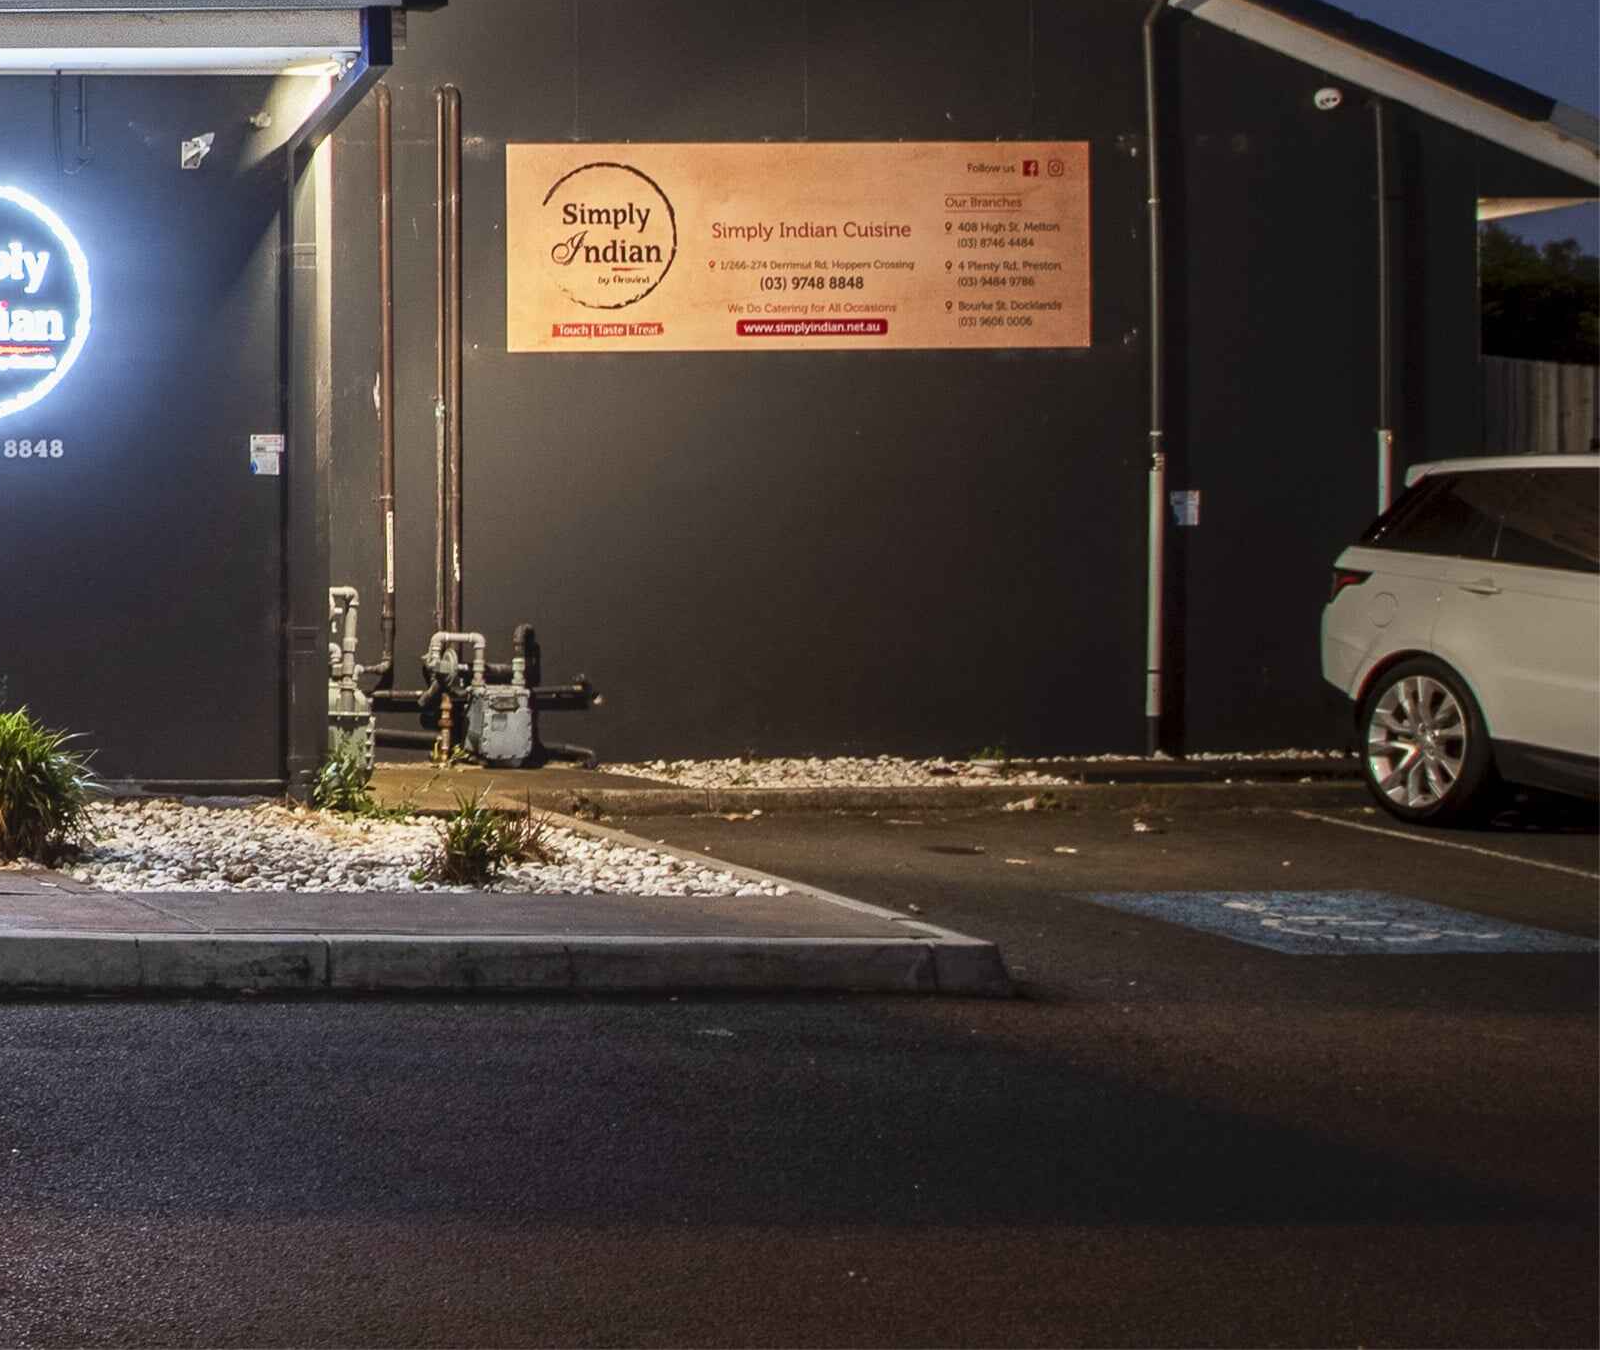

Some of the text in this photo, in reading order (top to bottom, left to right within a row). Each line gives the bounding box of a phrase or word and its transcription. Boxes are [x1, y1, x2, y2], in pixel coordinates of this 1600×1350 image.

[967, 163, 1015, 173] Follow us
[944, 196, 1022, 208] Our Branches
[562, 202, 651, 233] Simply
[712, 222, 912, 242] Simply Indian Cuisine
[980, 222, 1006, 234] High
[1023, 222, 1060, 232] Melton
[551, 230, 663, 266] Indian
[957, 238, 977, 248] (03)
[831, 260, 871, 271] Hoppers
[873, 260, 915, 271] Crossing
[958, 262, 965, 271] 4
[967, 261, 1000, 273] Plenty
[1022, 261, 1062, 271] Preston
[760, 276, 864, 291] (03) 9748 8848
[957, 277, 977, 287] (03)
[727, 303, 897, 315] We Do Catering for All Occasions
[1010, 300, 1062, 311] Docklands
[744, 321, 881, 334] www.simplyindian.net.au
[958, 316, 977, 328] (03)
[3, 439, 64, 458] 8848
